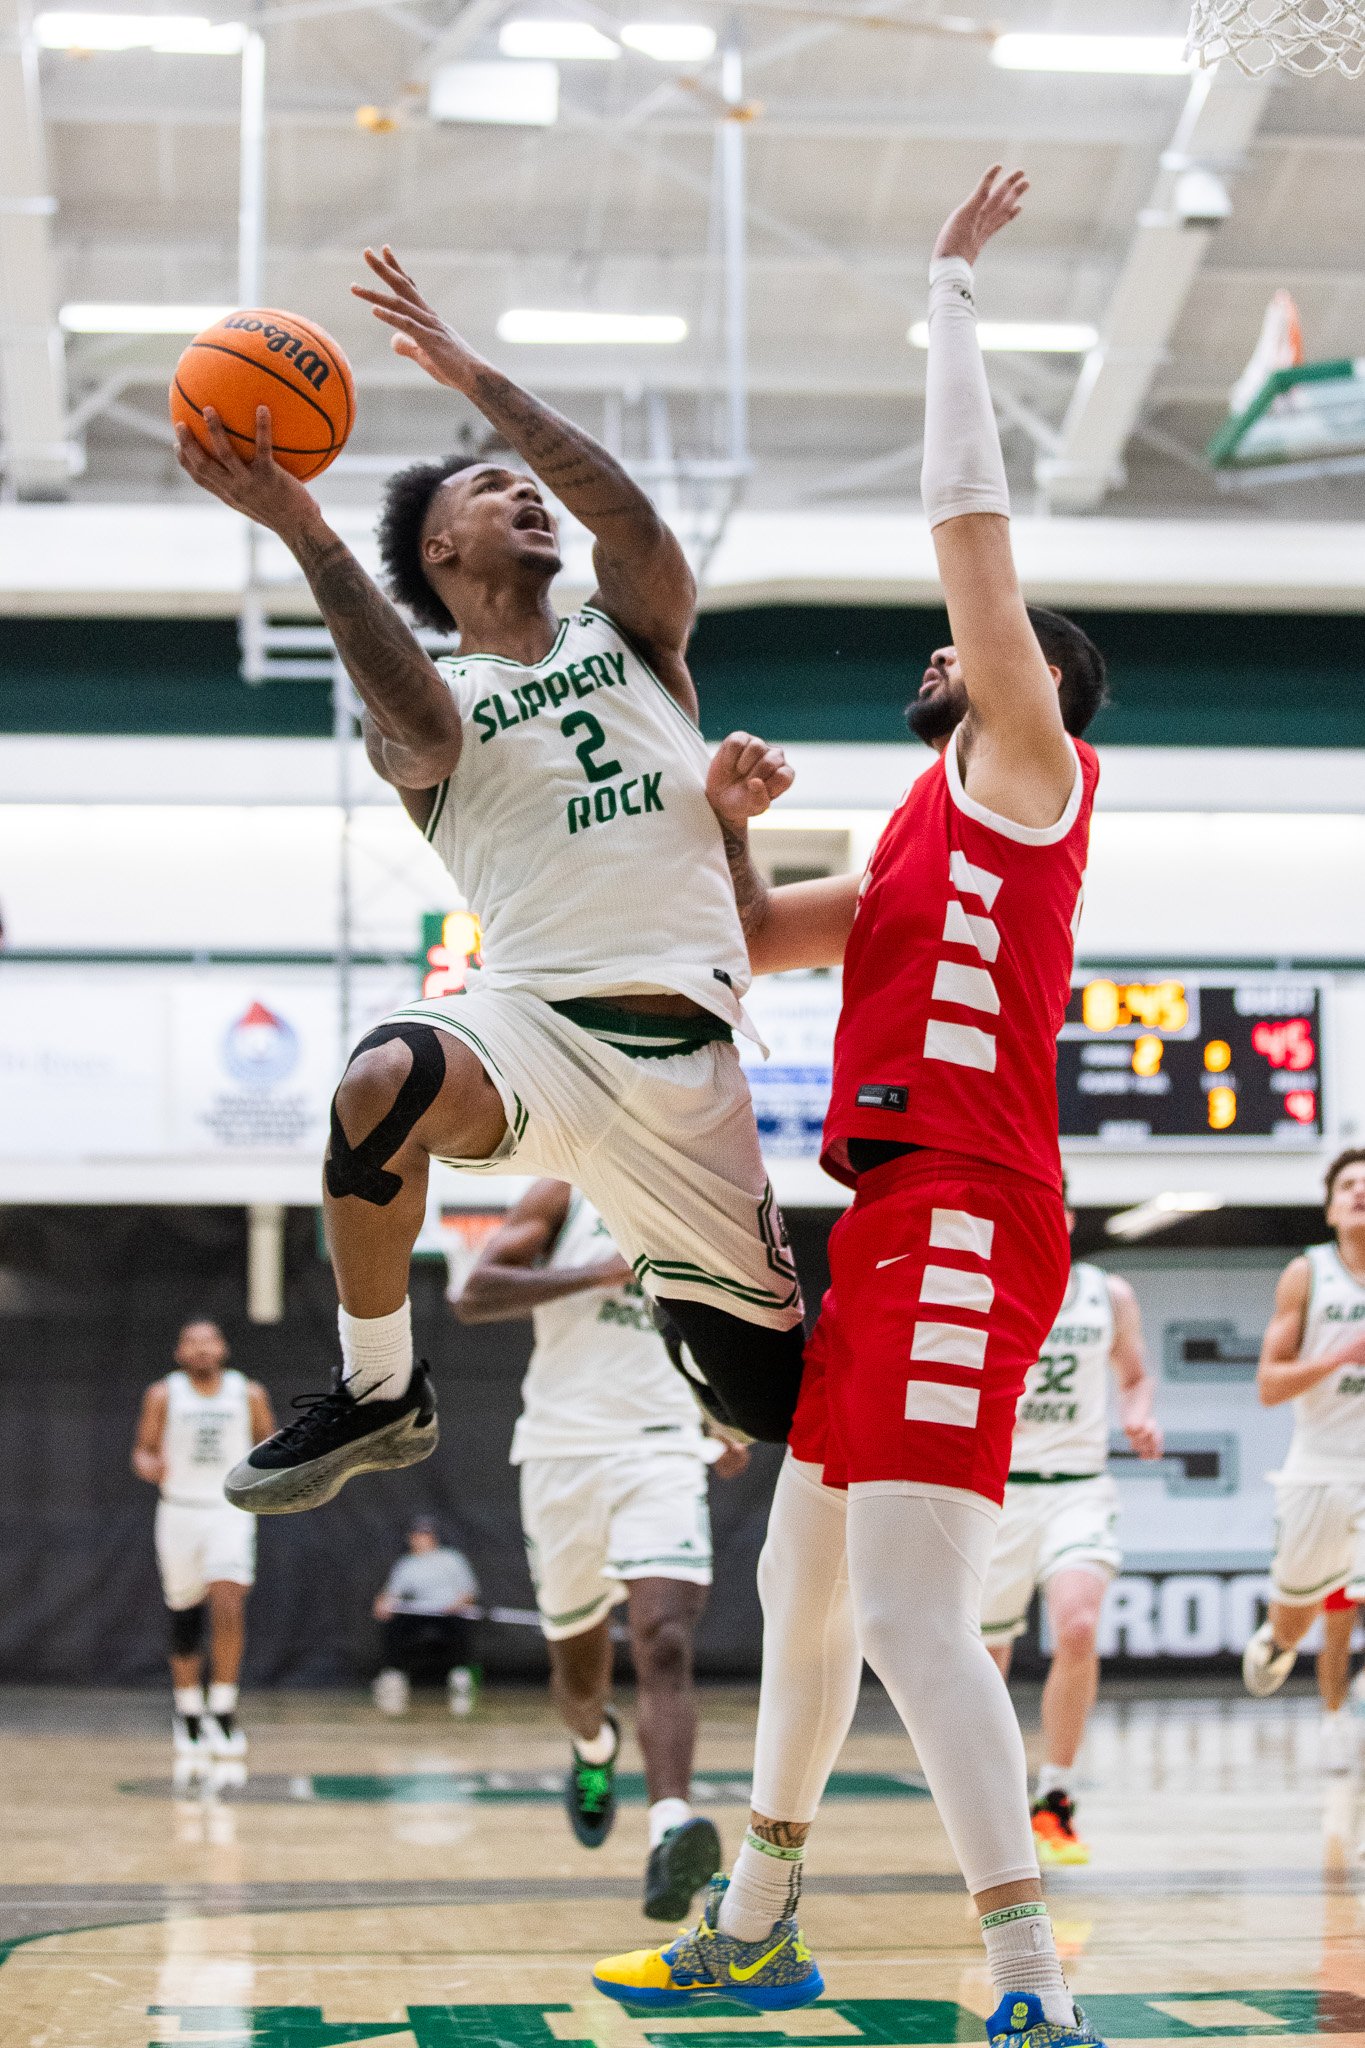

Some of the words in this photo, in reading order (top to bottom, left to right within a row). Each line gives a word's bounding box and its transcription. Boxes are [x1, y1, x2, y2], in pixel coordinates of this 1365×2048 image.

[224, 317, 330, 392] Wilson
[472, 651, 627, 744] SLIPPERY
[560, 710, 623, 783] 2
[566, 771, 665, 835] ROCK
[888, 1091, 900, 1104] XL
[1035, 1352, 1078, 1395] 32
